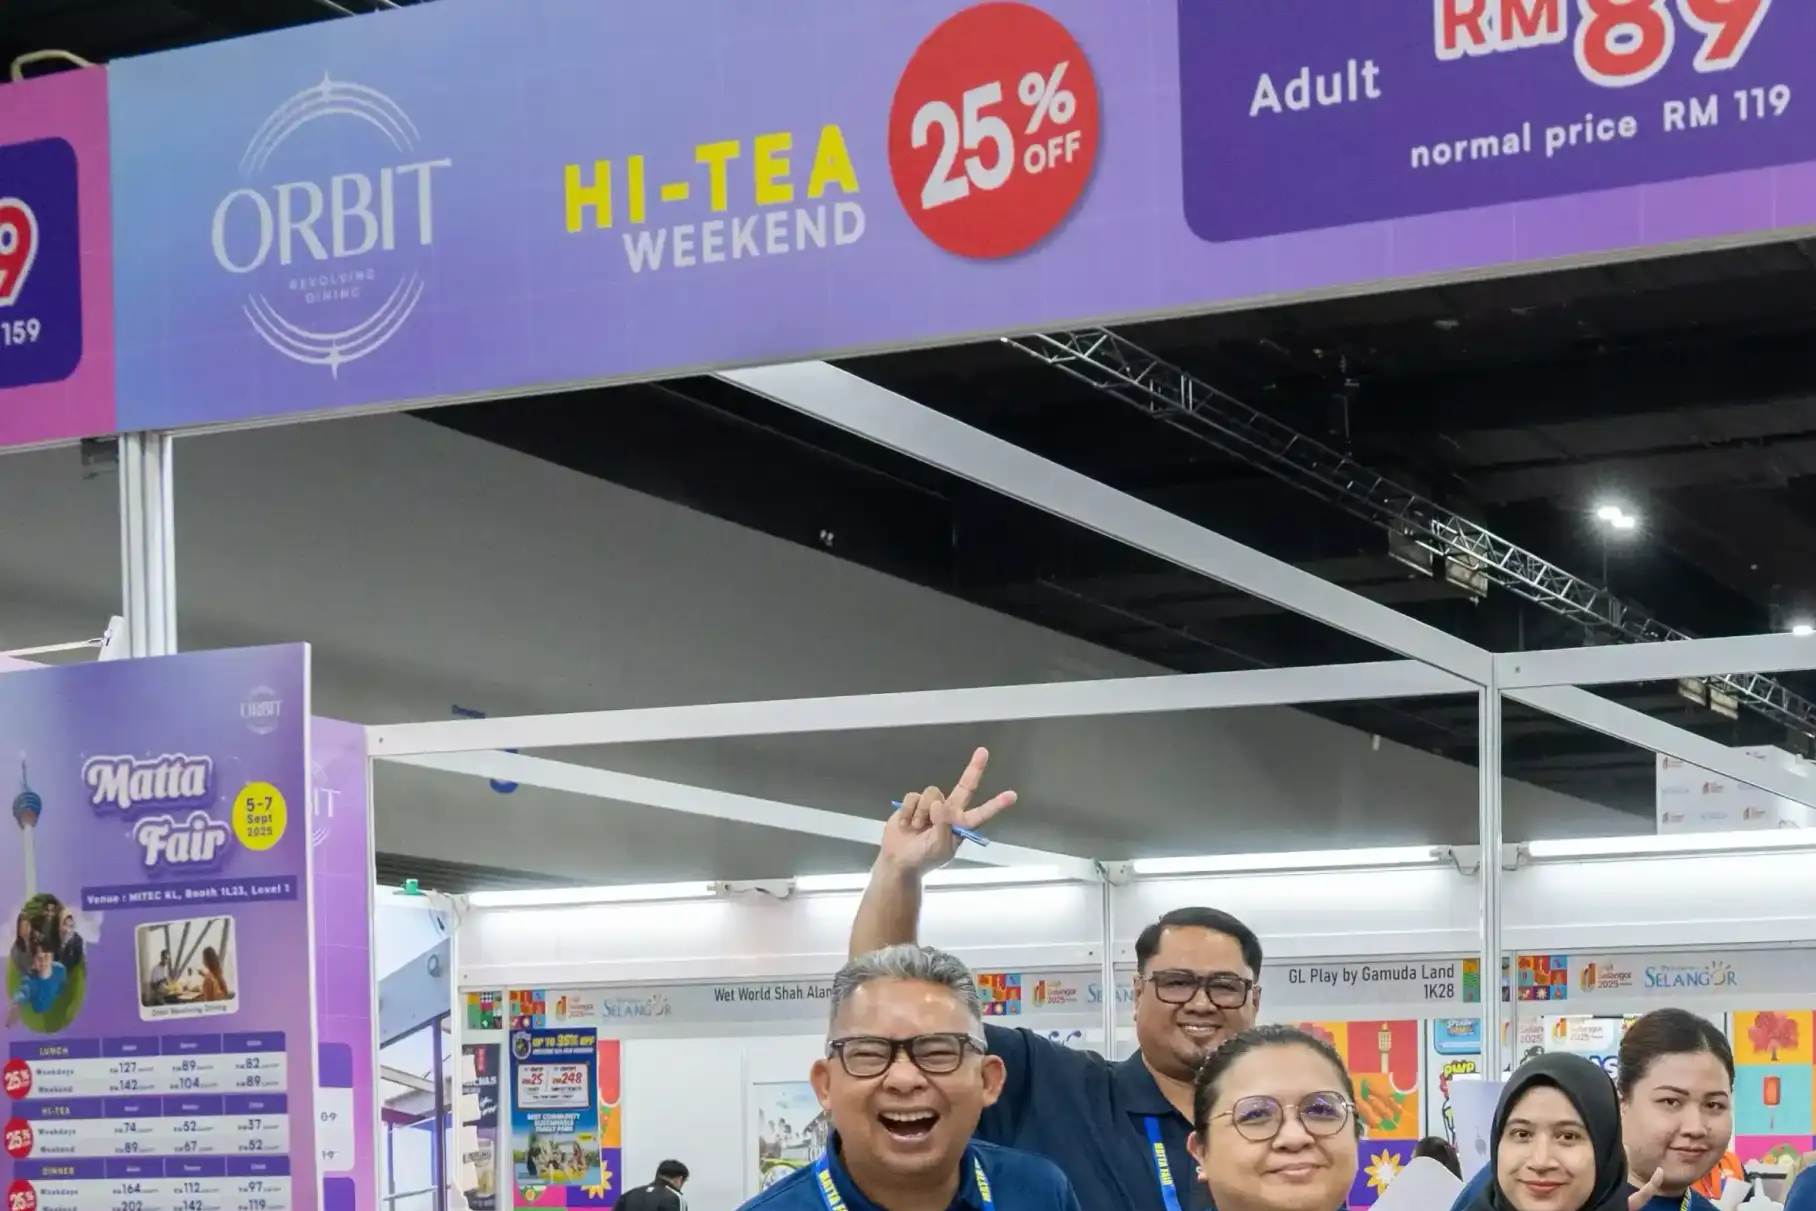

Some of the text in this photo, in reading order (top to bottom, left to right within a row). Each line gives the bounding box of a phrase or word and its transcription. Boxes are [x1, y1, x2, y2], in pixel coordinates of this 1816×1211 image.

[1249, 59, 1381, 117] Adult
[1024, 130, 1081, 175] OFF
[1411, 85, 1791, 169] normal price RM 119
[564, 125, 859, 233] HI-TEA
[212, 158, 451, 273] ORBIT
[622, 201, 865, 273] WEEKEND
[84, 758, 209, 811] Matta
[137, 816, 226, 866] Fair
[714, 988, 735, 1001] Wet
[738, 987, 771, 1001] World
[774, 986, 803, 1000] Shah
[1289, 964, 1454, 986] GL Play by Gamuda Land
[1424, 984, 1454, 999] 1K28
[818, 1168, 844, 1209] MATTA
